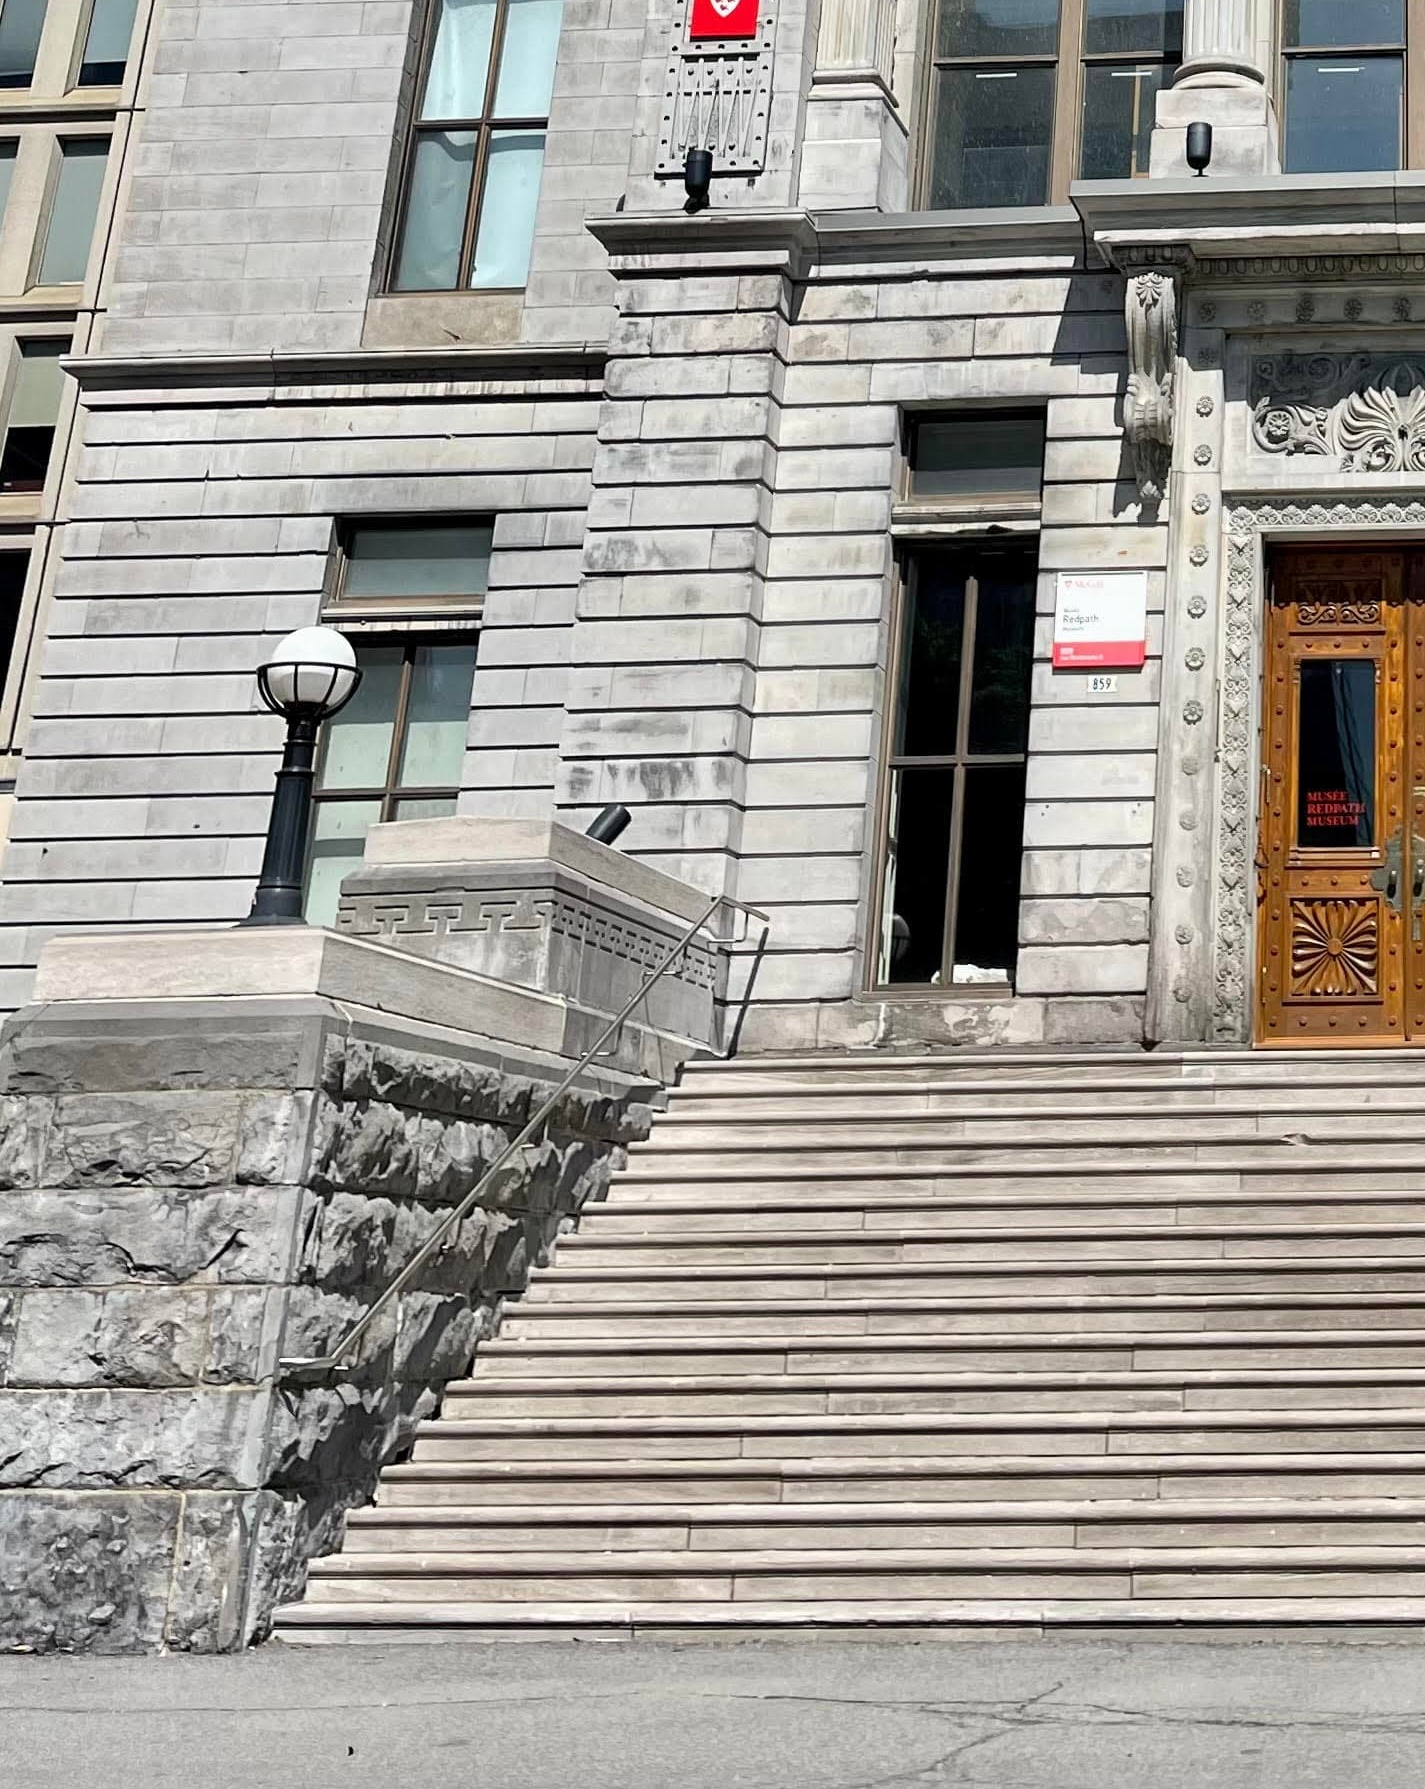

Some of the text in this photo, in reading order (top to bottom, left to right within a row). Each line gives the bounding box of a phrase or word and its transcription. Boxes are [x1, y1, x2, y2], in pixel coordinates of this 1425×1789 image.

[1062, 614, 1099, 624] Redpath
[1092, 678, 1112, 690] 859
[1306, 803, 1366, 814] REDPATH
[1306, 815, 1359, 826] MUSEUM
